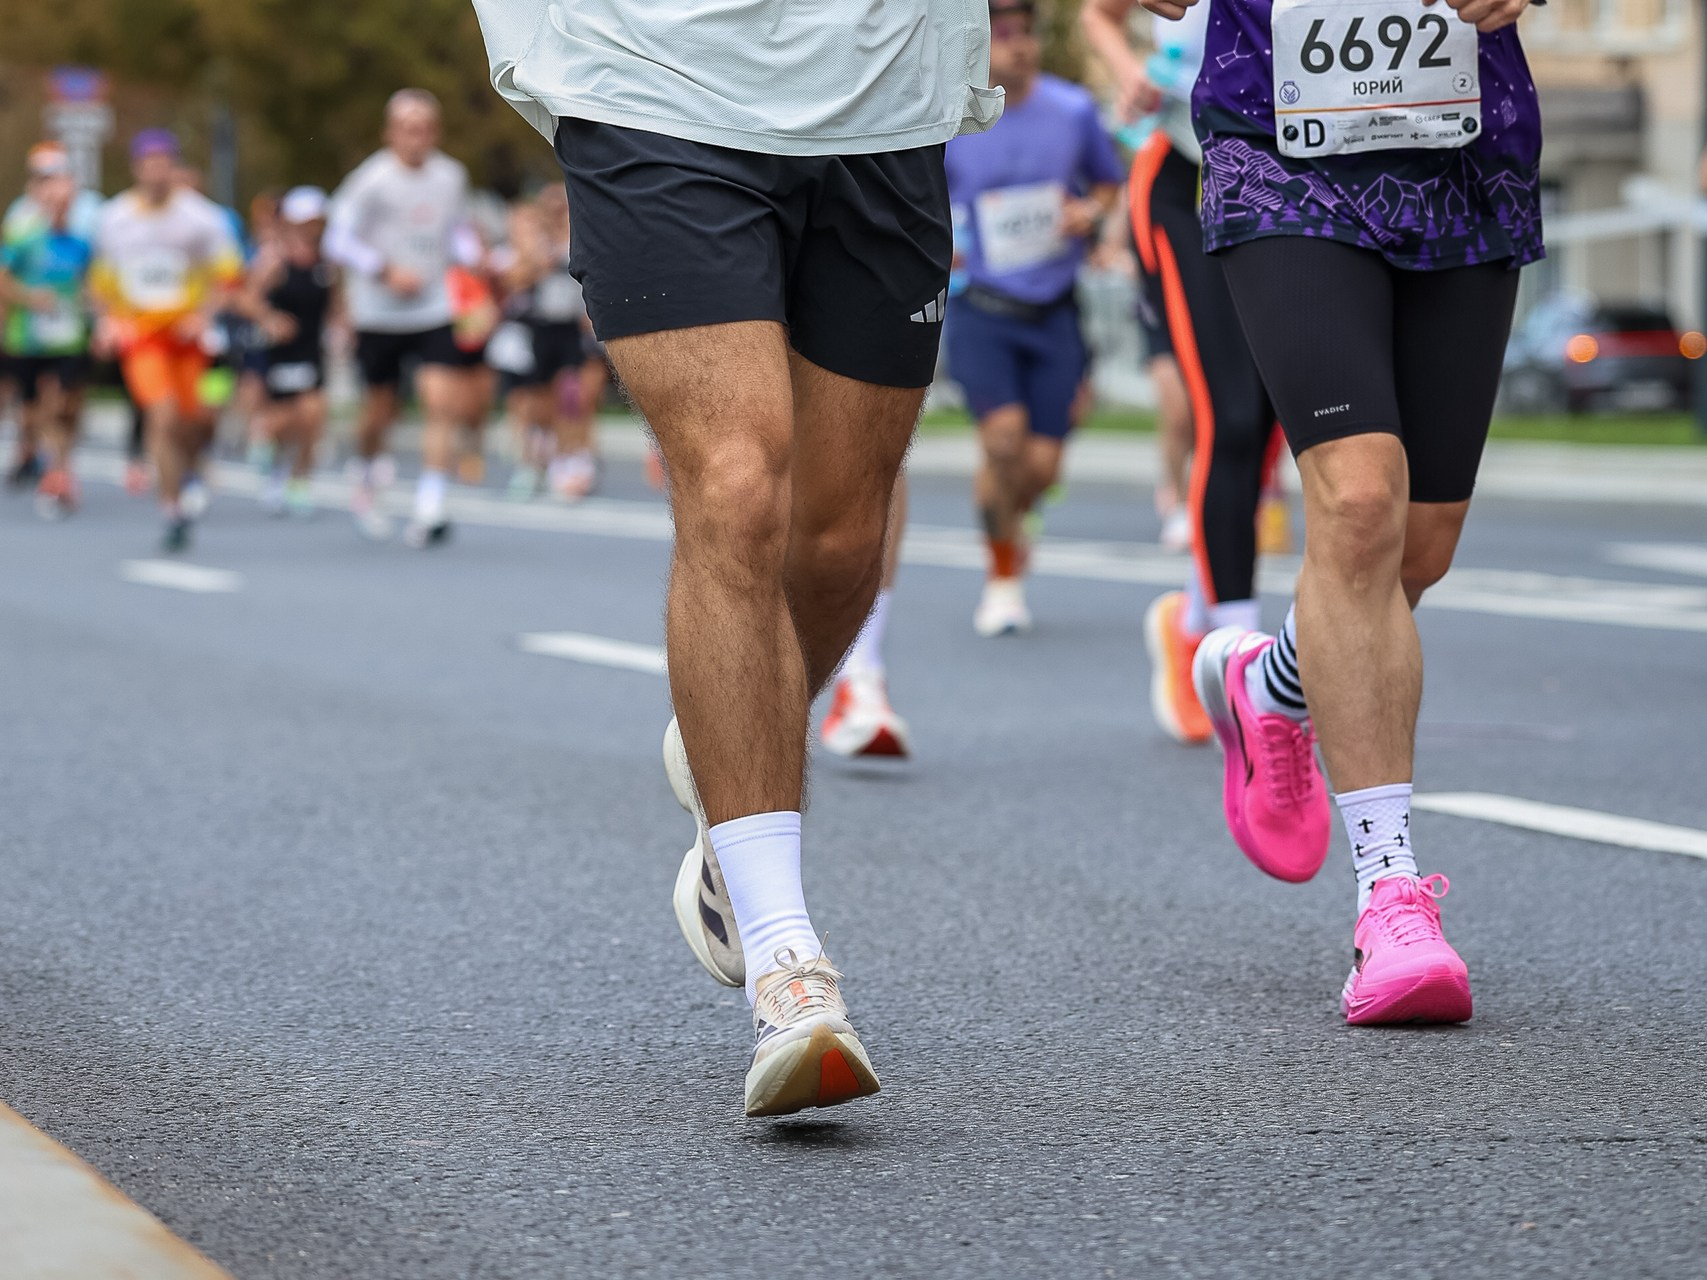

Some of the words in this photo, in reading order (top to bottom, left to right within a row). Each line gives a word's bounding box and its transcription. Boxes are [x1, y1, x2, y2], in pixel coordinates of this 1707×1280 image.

[1300, 13, 1451, 74] 6692
[1353, 76, 1403, 95] ЮРИЙ
[1459, 78, 1467, 88] 2
[1303, 119, 1325, 148] D
[1314, 404, 1350, 417] EVADICT
